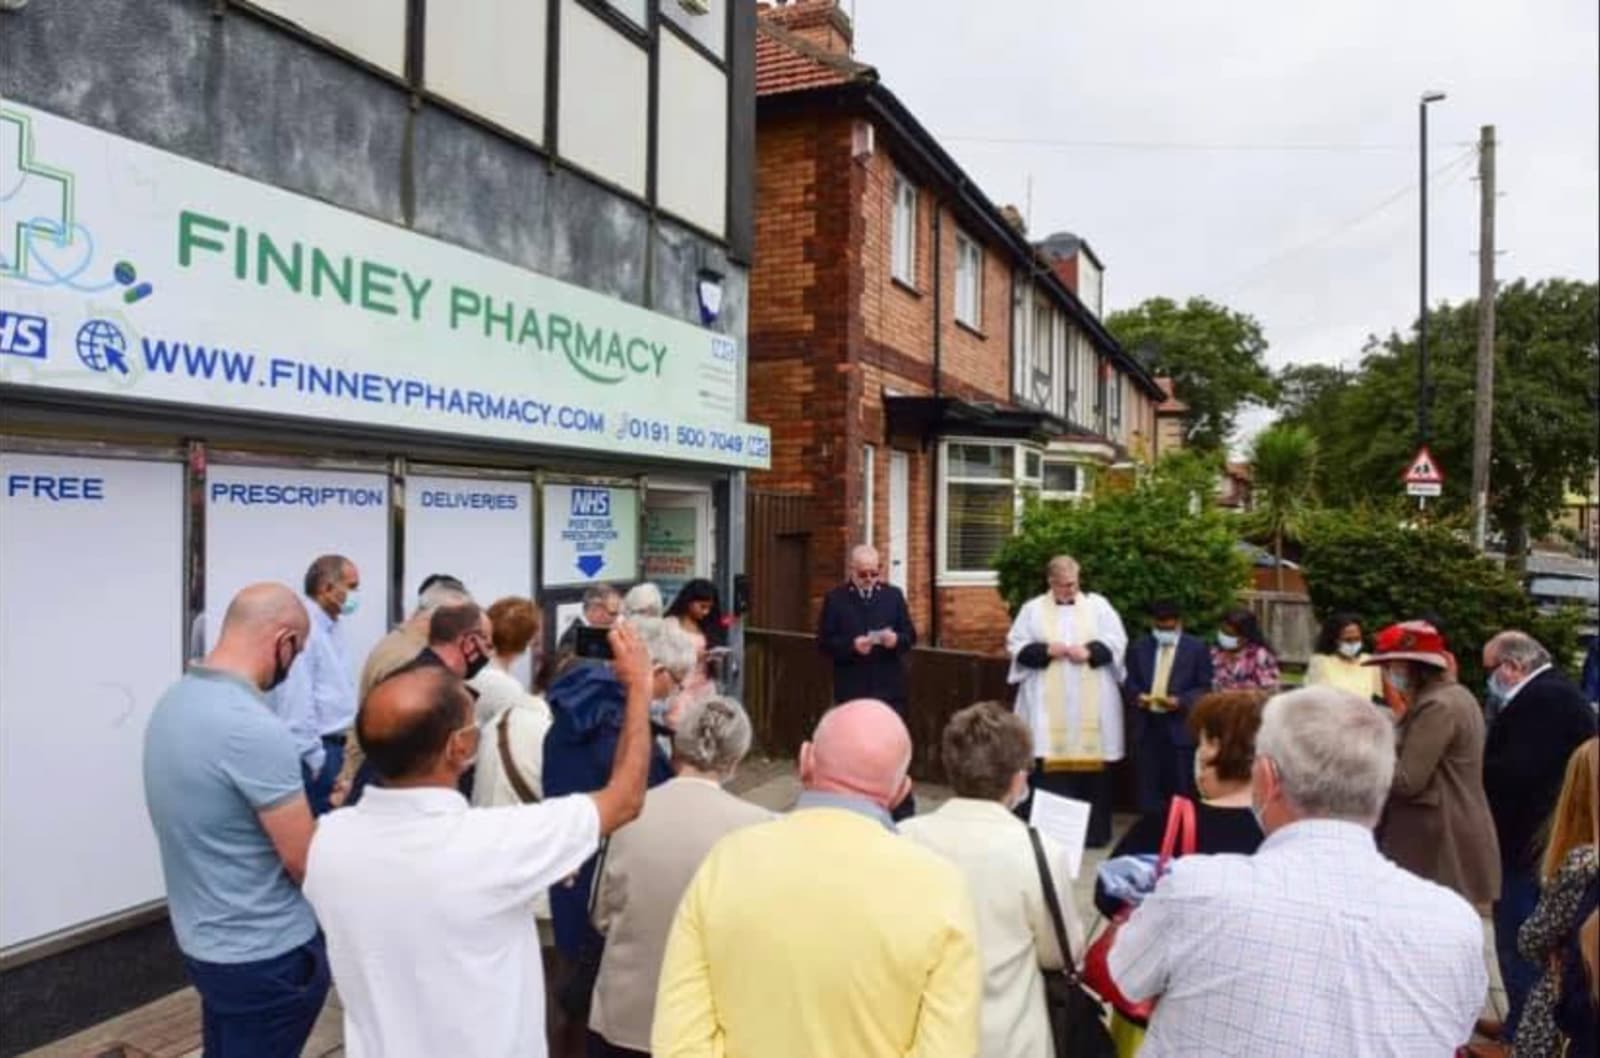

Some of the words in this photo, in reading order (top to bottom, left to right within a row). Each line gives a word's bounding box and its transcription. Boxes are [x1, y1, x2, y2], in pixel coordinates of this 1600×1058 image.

[178, 210, 431, 320] FINNEY
[450, 287, 668, 384] PHARMACY
[0, 314, 44, 356] HS
[142, 336, 605, 432] WWW.FINNEYPHARMACY.COM
[629, 418, 669, 442] 0191
[677, 426, 705, 447] 500
[709, 431, 742, 453] 7049
[8, 475, 104, 501] FREE
[211, 483, 384, 507] PRESCRIPTION
[421, 491, 518, 510] DELIVERIES
[573, 490, 609, 515] NHS
